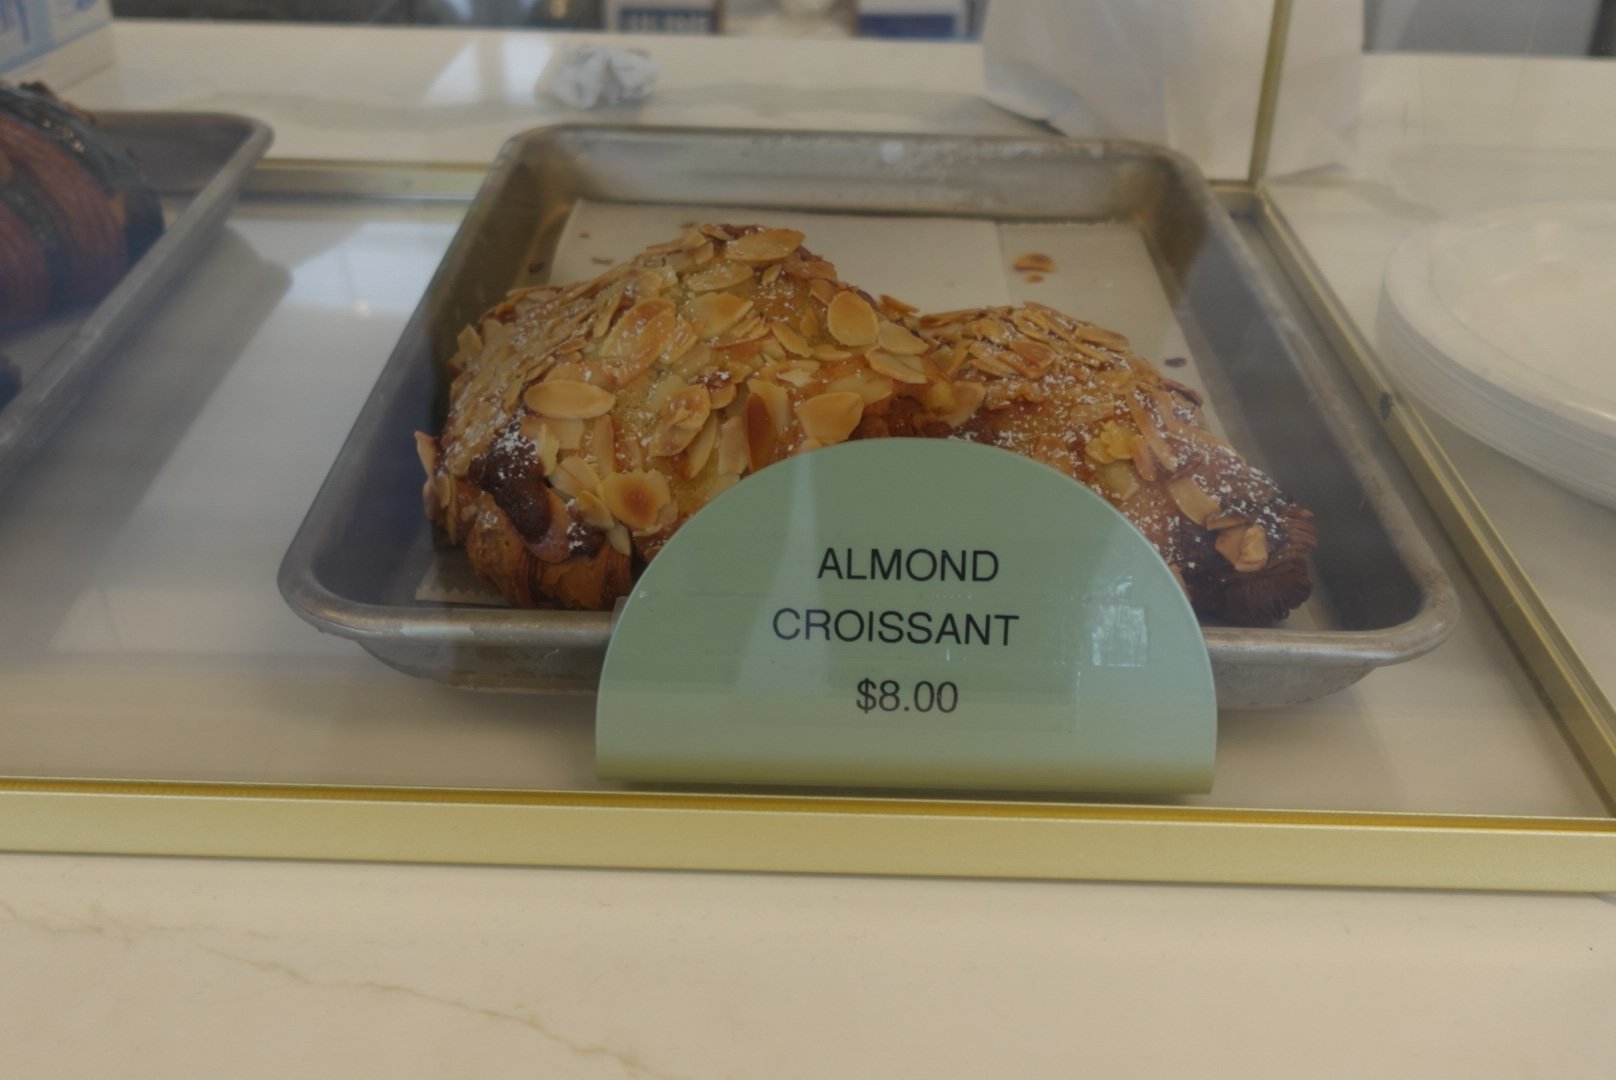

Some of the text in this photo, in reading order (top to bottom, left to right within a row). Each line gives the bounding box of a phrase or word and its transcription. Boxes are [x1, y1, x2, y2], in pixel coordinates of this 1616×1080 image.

[817, 547, 999, 582] ALMOND
[772, 607, 1020, 647] CROISSANT
[856, 677, 959, 714] $8.00
